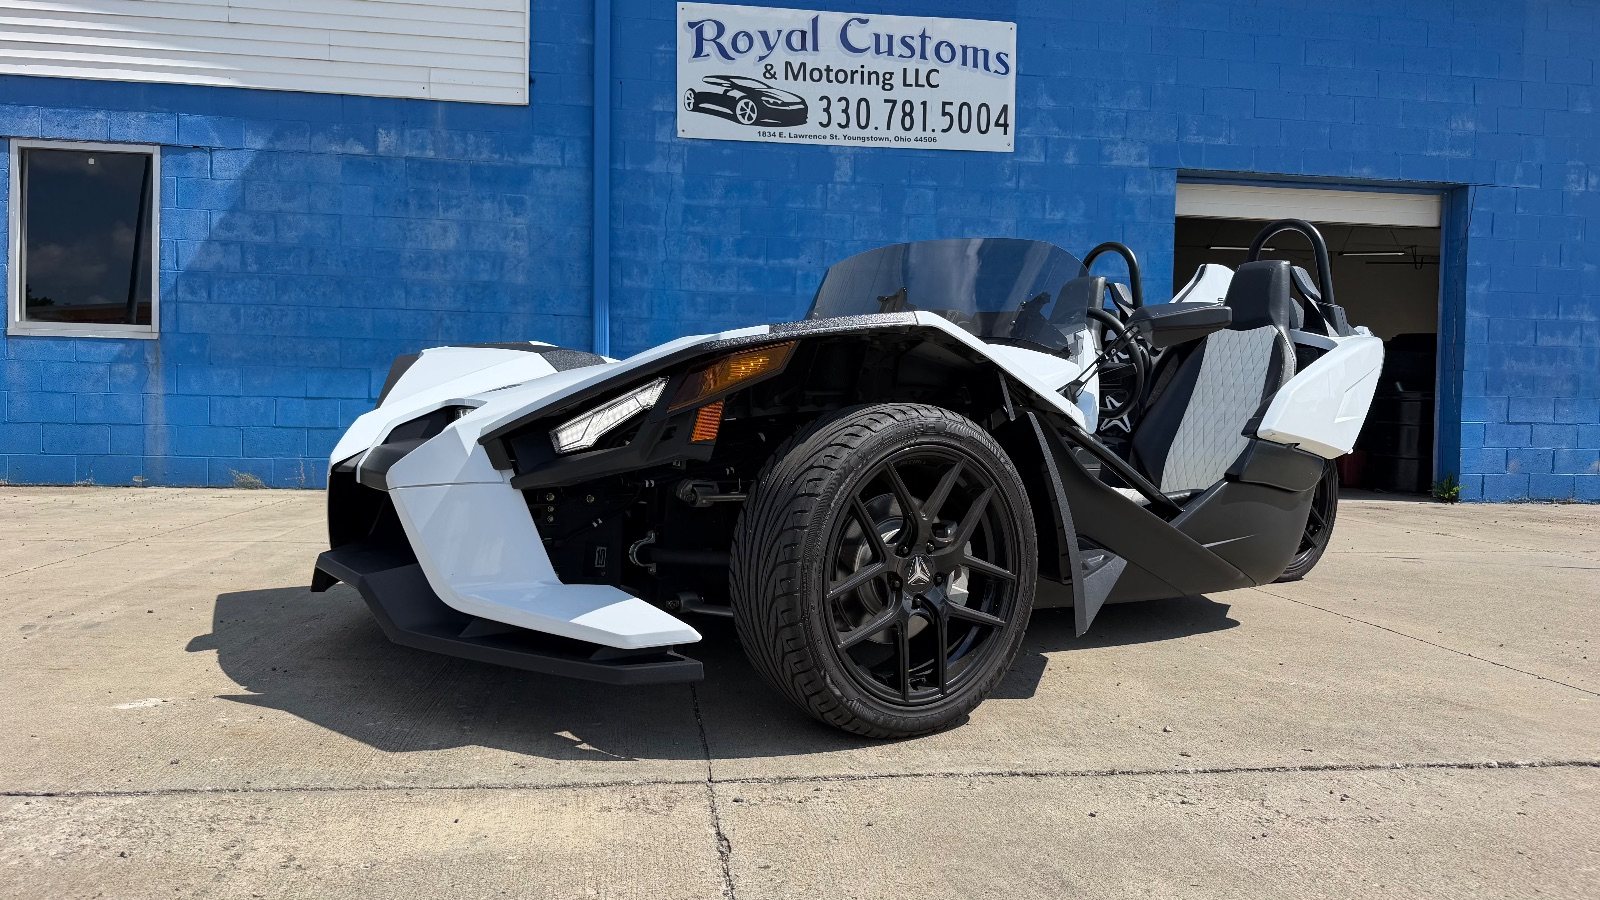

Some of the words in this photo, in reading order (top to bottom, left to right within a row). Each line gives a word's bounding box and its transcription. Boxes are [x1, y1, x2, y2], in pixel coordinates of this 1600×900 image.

[687, 14, 820, 62] Royal
[839, 17, 1010, 76] Customs
[762, 63, 778, 81] &
[784, 60, 895, 92] Motoring
[902, 67, 940, 89] LLC
[818, 95, 1010, 136] 330.781.5004
[757, 130, 777, 138] 1834
[778, 131, 787, 139] E.
[788, 132, 827, 140] Lawrence
[829, 133, 840, 141] St.
[842, 134, 892, 143] Youngstown,
[893, 135, 912, 143] Ohio
